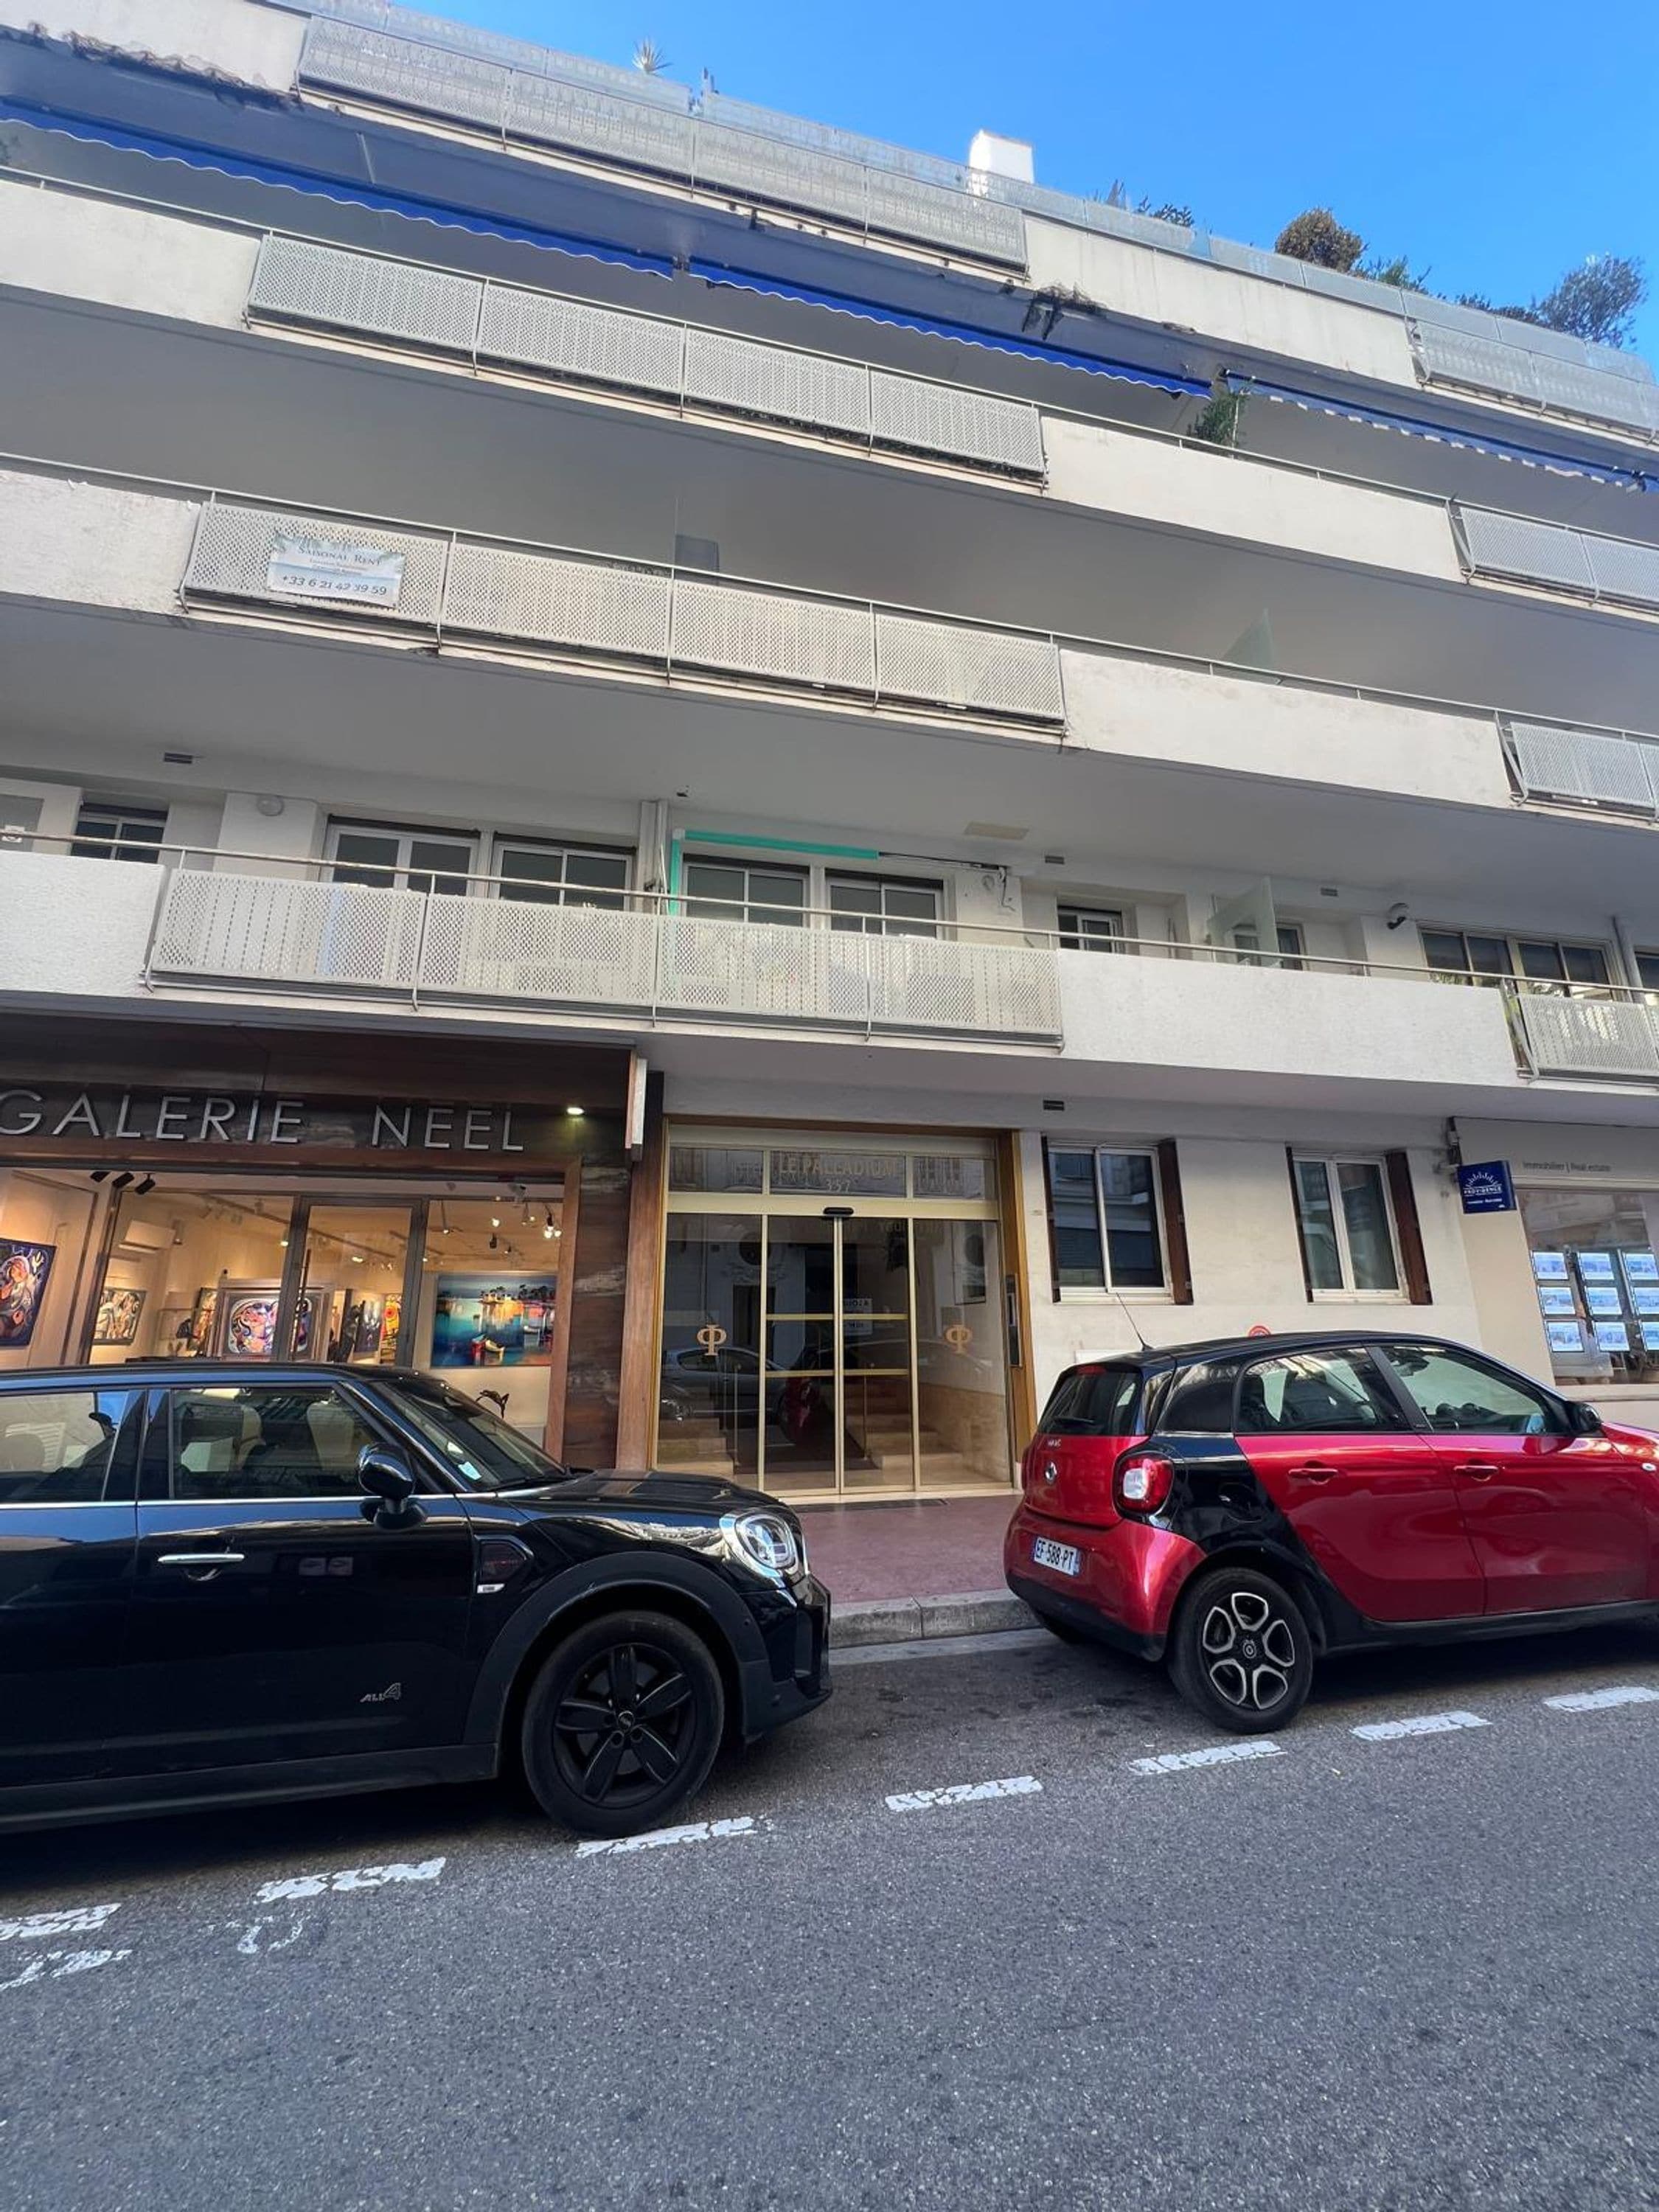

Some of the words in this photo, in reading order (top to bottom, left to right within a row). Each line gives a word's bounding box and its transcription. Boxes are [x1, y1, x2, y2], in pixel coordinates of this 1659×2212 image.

[355, 554, 382, 566] RENT
[283, 575, 305, 586] +33
[308, 579, 318, 587] 6
[319, 580, 333, 589] 21
[335, 582, 351, 591] 42
[371, 586, 387, 596] 59
[0, 1089, 304, 1143] GALERIE
[372, 1105, 524, 1151] NEEL
